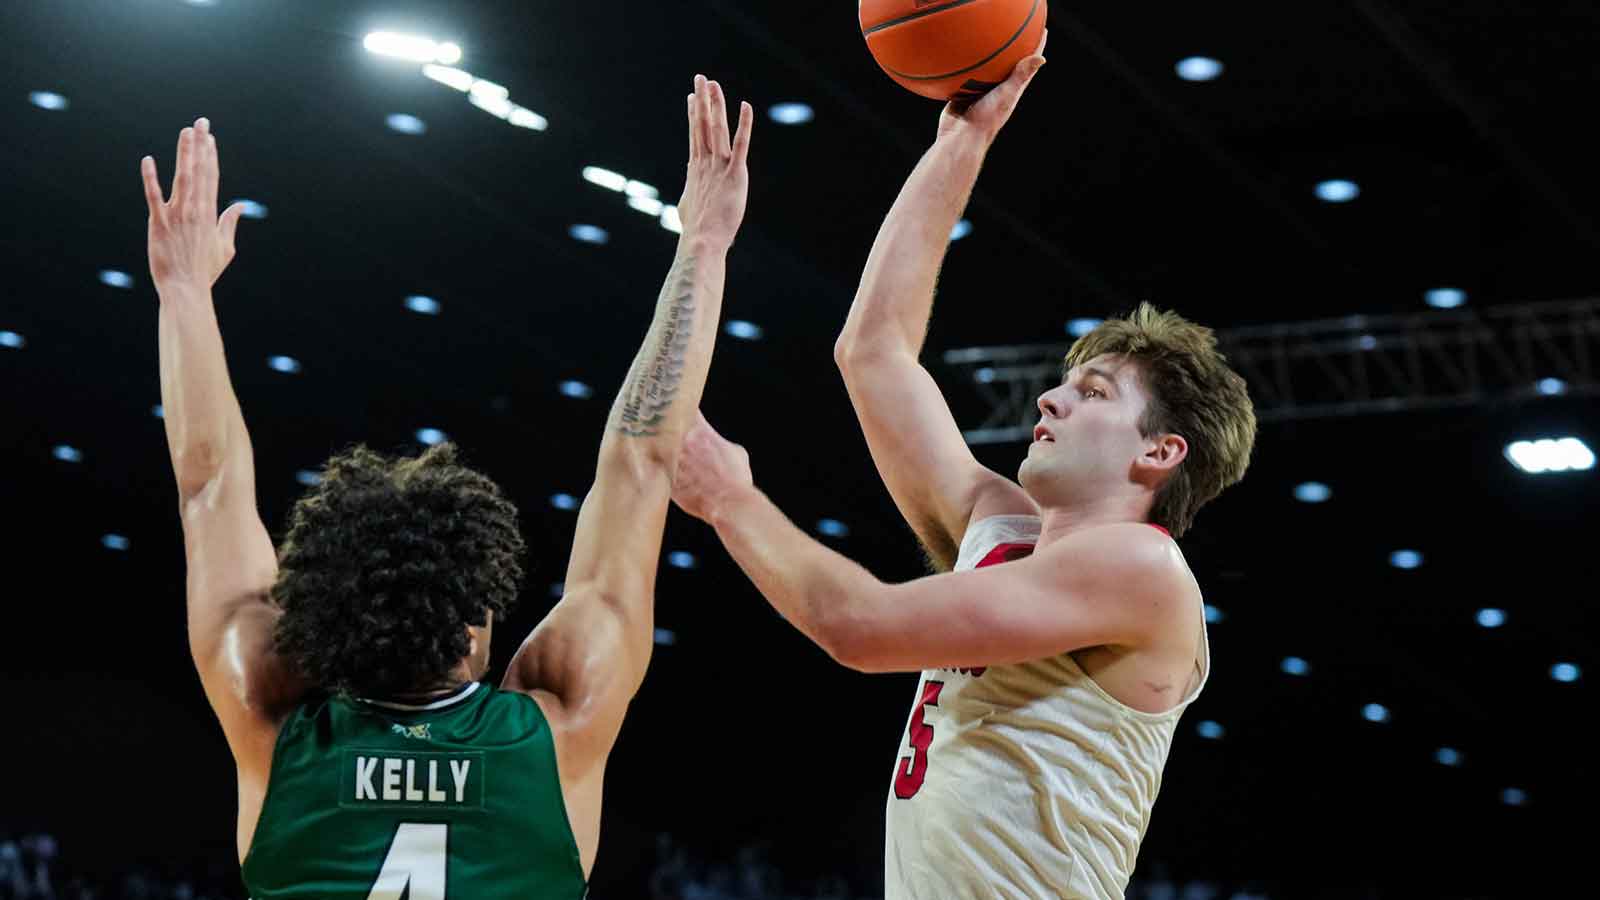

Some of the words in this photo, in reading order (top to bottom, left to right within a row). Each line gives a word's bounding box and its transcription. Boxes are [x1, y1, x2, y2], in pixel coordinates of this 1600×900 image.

[893, 680, 943, 800] 5
[355, 756, 470, 803] KELLY
[367, 822, 448, 900] 4
